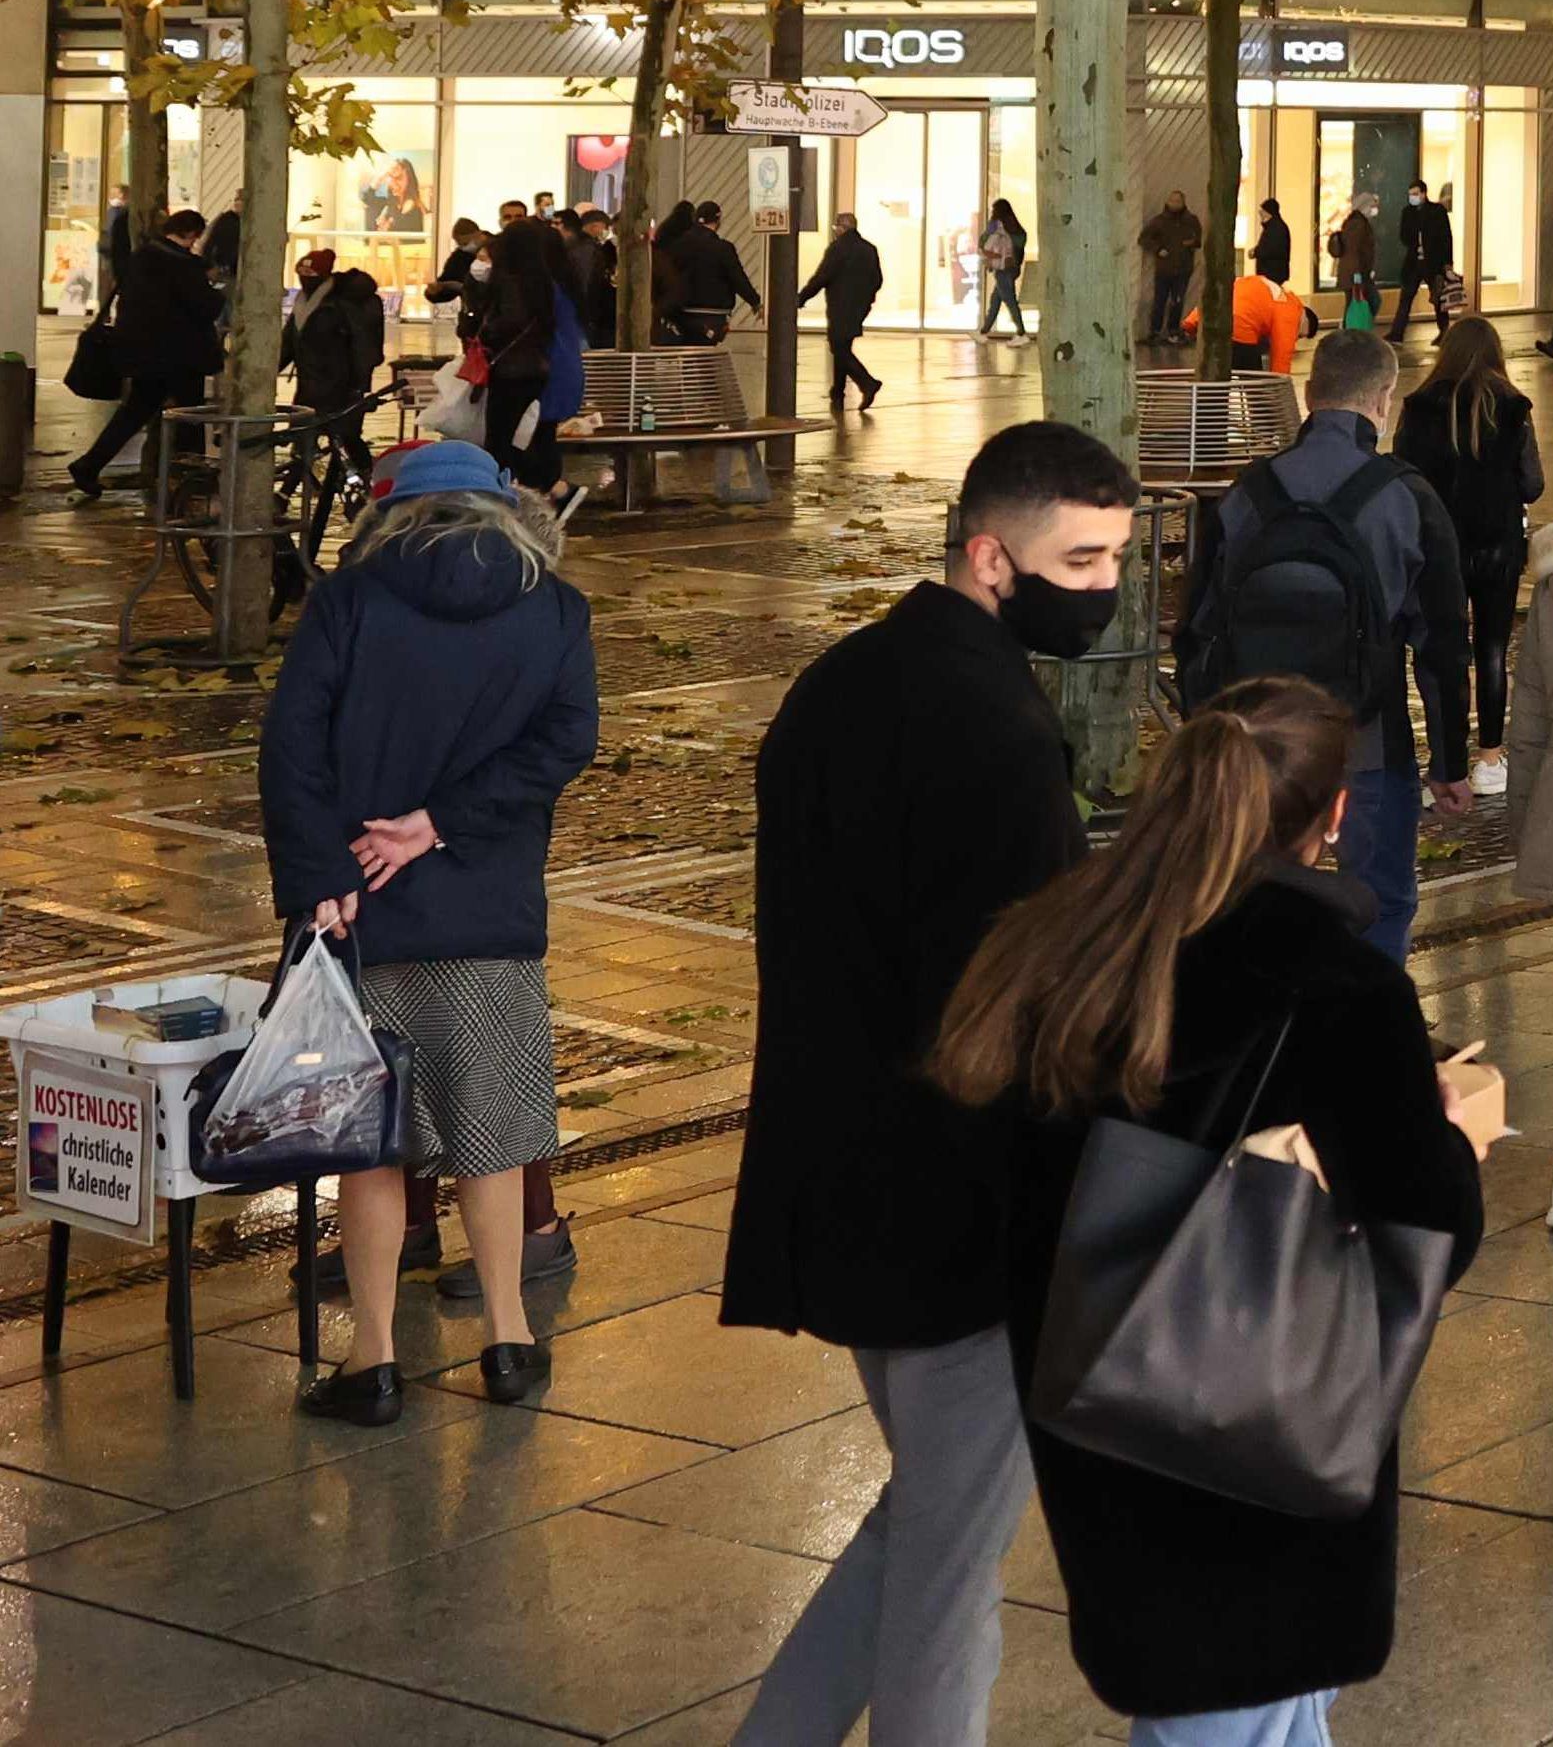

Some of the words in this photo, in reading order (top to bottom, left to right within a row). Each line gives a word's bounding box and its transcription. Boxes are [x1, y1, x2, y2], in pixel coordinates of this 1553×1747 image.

[844, 29, 964, 69] IQOS
[1283, 40, 1345, 64] IQOS
[753, 91, 845, 113] Stadolizei
[745, 113, 805, 128] Hauptwache
[808, 116, 849, 130] B-Ebene
[34, 1084, 138, 1132] KOSTENLOSE
[62, 1132, 134, 1170] christliche
[67, 1166, 132, 1202] Kalender
